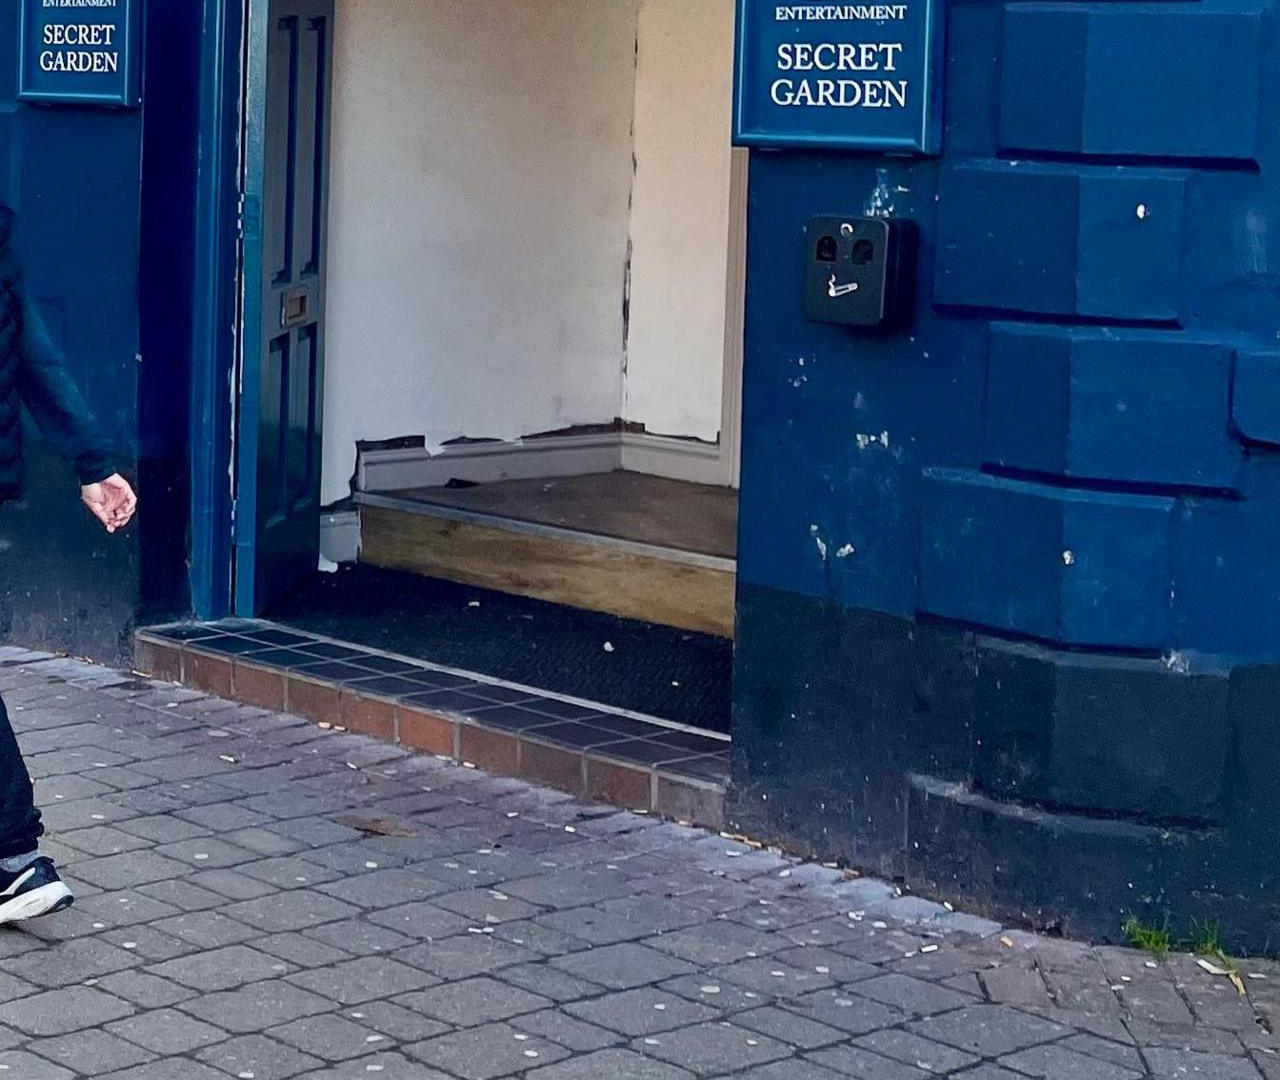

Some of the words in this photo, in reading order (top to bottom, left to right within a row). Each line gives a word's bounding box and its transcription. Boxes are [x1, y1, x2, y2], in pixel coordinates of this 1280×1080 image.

[774, 5, 908, 21] ENTERTAINMENT
[43, 23, 116, 46] SECRET
[39, 51, 119, 73] GARDEN
[776, 42, 903, 72] SECRET
[769, 78, 908, 108] GARDEN
